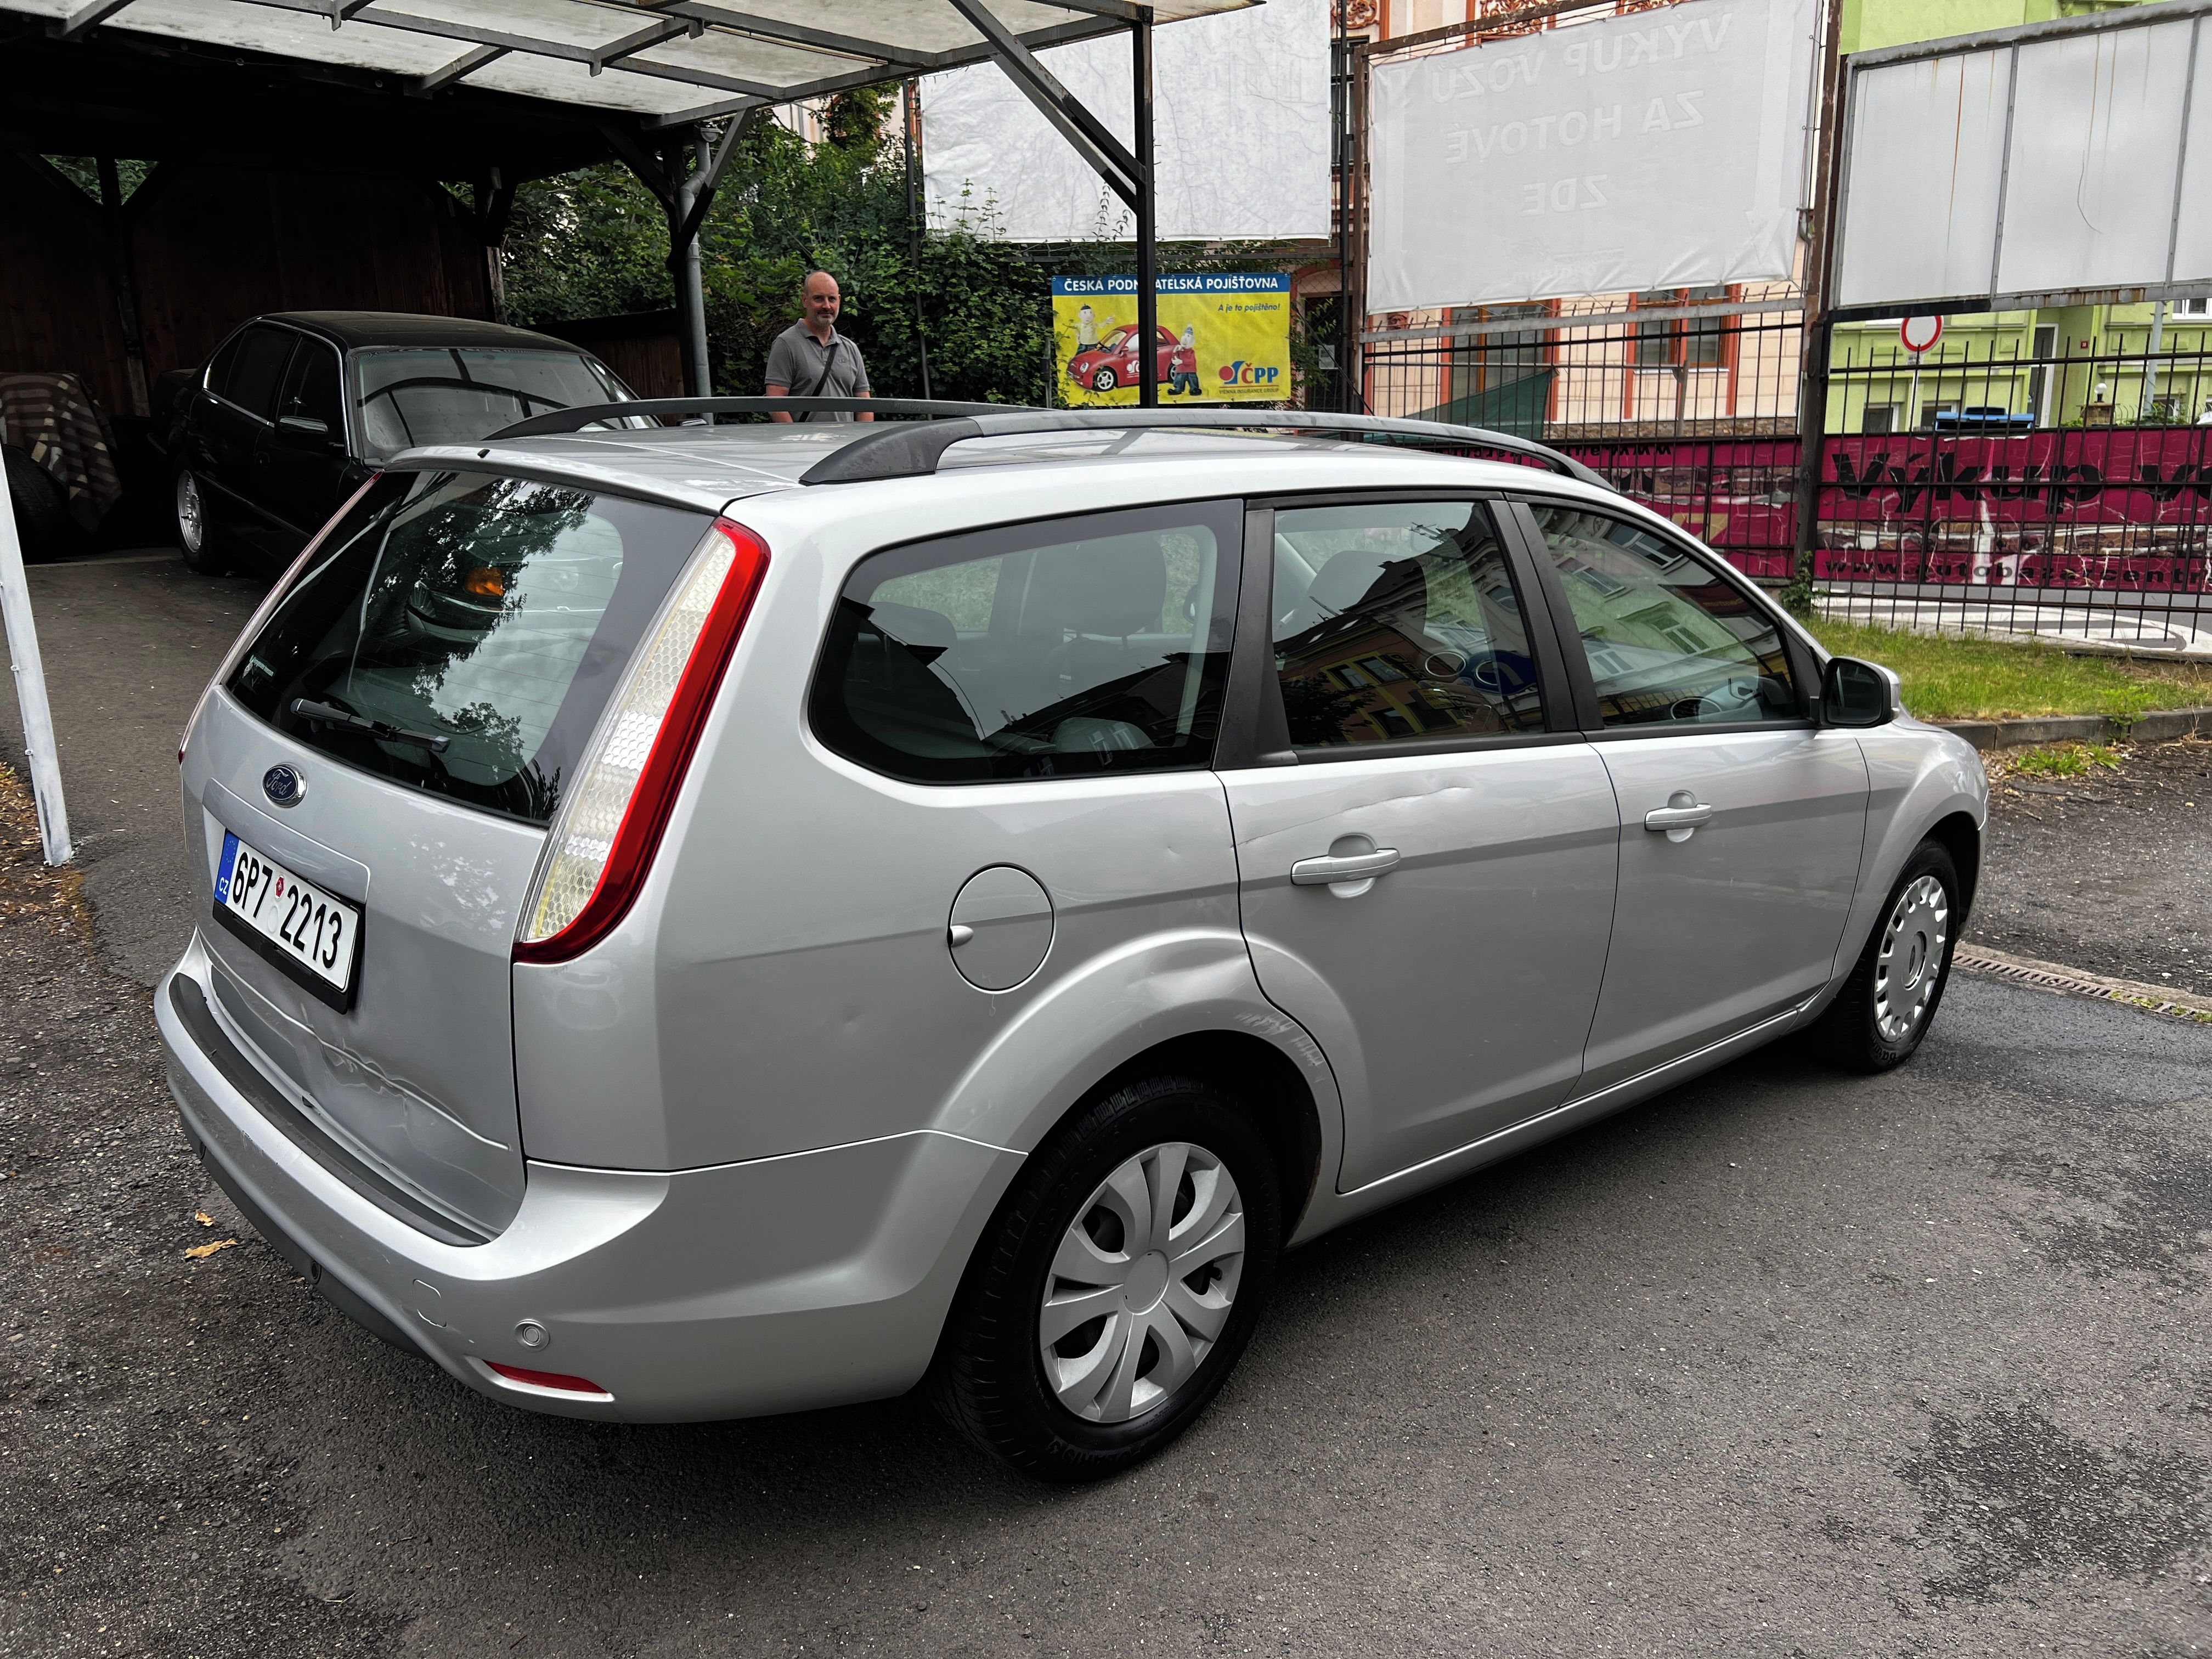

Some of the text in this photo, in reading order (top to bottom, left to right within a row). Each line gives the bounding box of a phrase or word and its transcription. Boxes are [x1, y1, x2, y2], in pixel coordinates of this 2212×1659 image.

[1064, 276, 1278, 291] ČESKÁ PODNATELSKÁ POJIŠŤOVNA
[1226, 304, 1233, 313] je
[1244, 303, 1280, 313] pojištěno!
[1241, 363, 1278, 384] ČPP
[1832, 453, 2103, 514] Výkup
[266, 769, 292, 795] Ford
[219, 877, 228, 895] CZ
[233, 852, 342, 969] 6P7 2213
